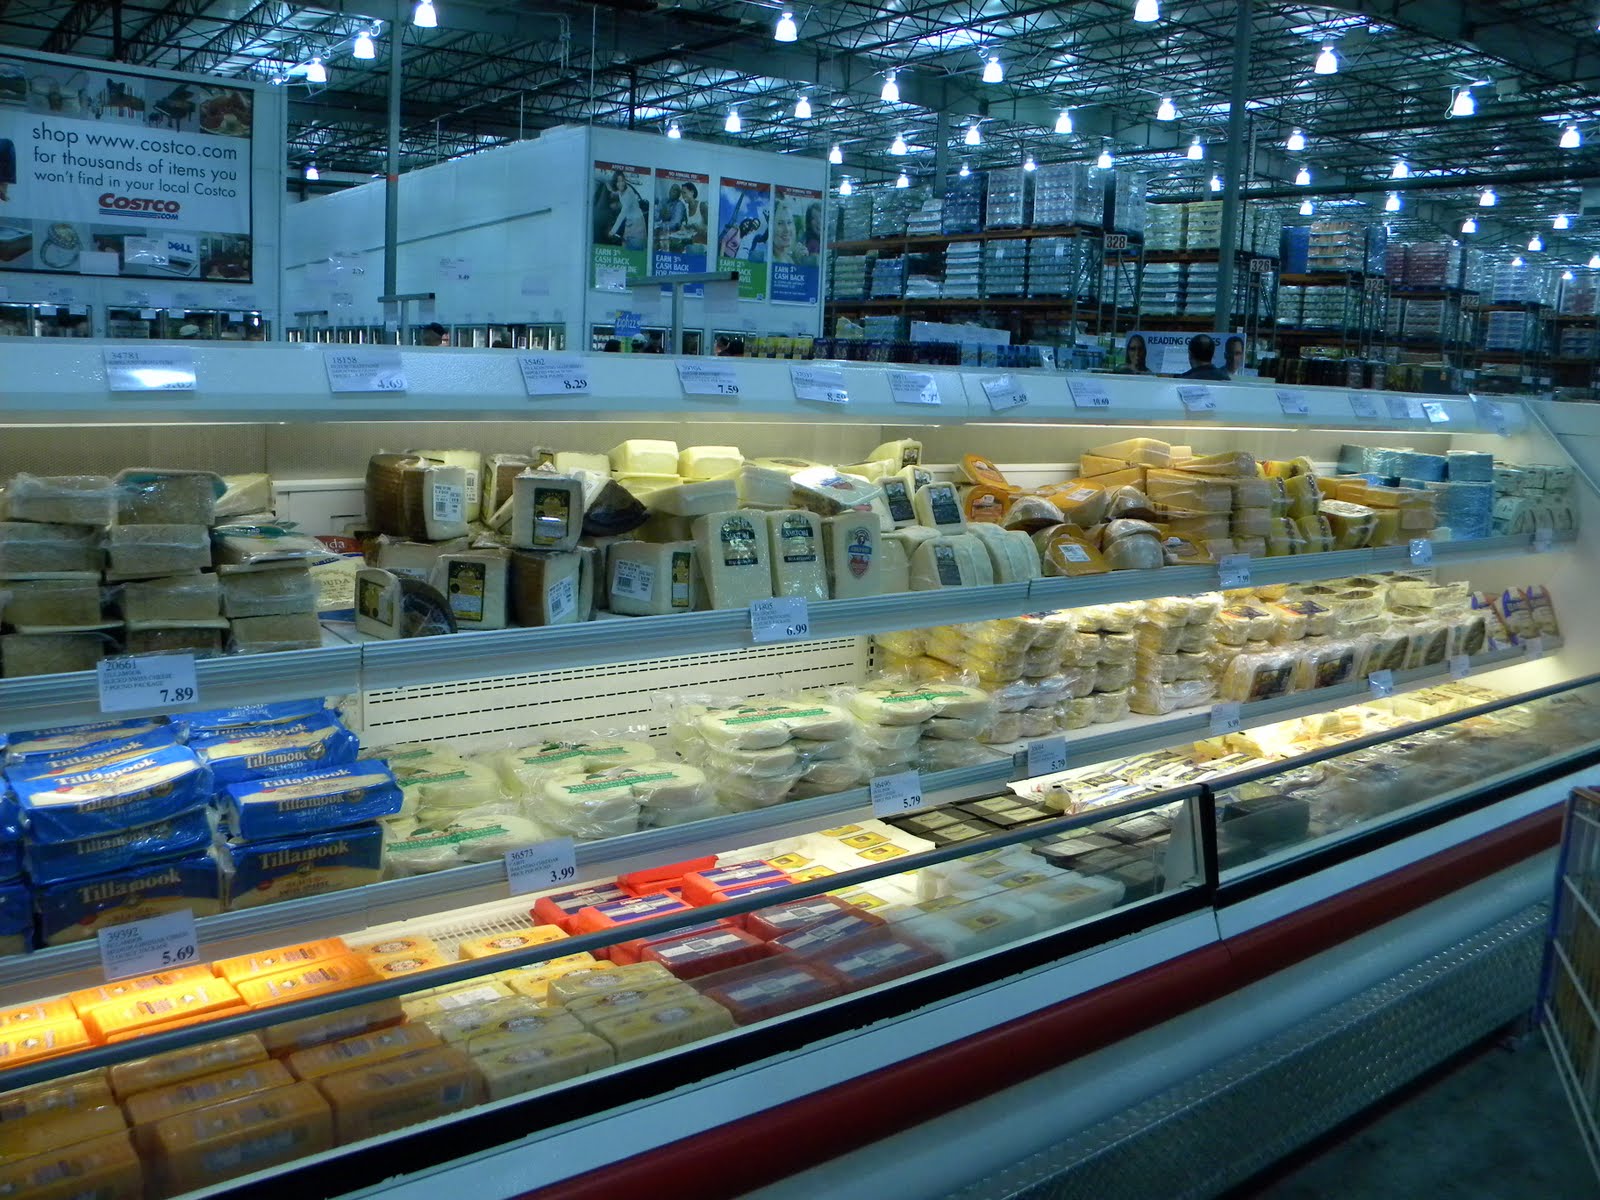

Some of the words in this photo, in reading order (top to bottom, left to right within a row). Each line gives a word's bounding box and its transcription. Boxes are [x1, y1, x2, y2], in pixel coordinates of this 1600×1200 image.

[32, 121, 79, 148] shop
[86, 133, 237, 160] www.costco.com
[34, 146, 56, 163] for
[63, 150, 142, 172] thousands
[148, 158, 164, 173] of
[168, 161, 206, 178] items
[211, 169, 237, 183] you
[34, 171, 73, 183] won't
[78, 171, 103, 186] find
[109, 176, 120, 187] in
[125, 180, 154, 192] your
[159, 179, 189, 193] local
[194, 183, 236, 198] Costco
[168, 241, 193, 253] DELL
[1106, 235, 1126, 249] 328
[595, 248, 611, 256] EARN
[595, 256, 612, 265] CASH
[613, 257, 630, 265] BACK
[656, 255, 672, 263] EARN
[720, 259, 735, 267] EARN
[655, 263, 672, 271] CASH
[774, 265, 788, 273] EARN
[1251, 260, 1270, 271] 326
[774, 273, 789, 281] CASH
[790, 273, 805, 281] BACK
[1365, 280, 1383, 290] 324
[1462, 296, 1478, 305] 322
[1148, 336, 1183, 345] READING
[111, 352, 139, 360] 34781
[332, 356, 357, 364] 18158
[377, 378, 404, 389] 4.69
[564, 379, 588, 390] 8.29
[718, 384, 739, 394] 7.59
[786, 623, 807, 636] 6.99
[105, 659, 137, 671] 20661
[148, 673, 172, 681] CHEESE
[134, 680, 164, 688] PACKAGE
[160, 687, 194, 703] 7.89
[46, 741, 144, 768] Tillamook
[267, 761, 303, 771] SLICED
[1051, 758, 1066, 770] 5.79
[54, 758, 157, 785] Tillamook
[259, 768, 351, 788] Tillamook
[278, 794, 345, 812] Tillamook
[903, 795, 921, 808] 5.79
[258, 840, 349, 870] Tillamook
[511, 848, 534, 861] 36573
[551, 866, 575, 883] 3.99
[77, 867, 182, 904] Tillamook
[162, 944, 195, 965] 5.69
